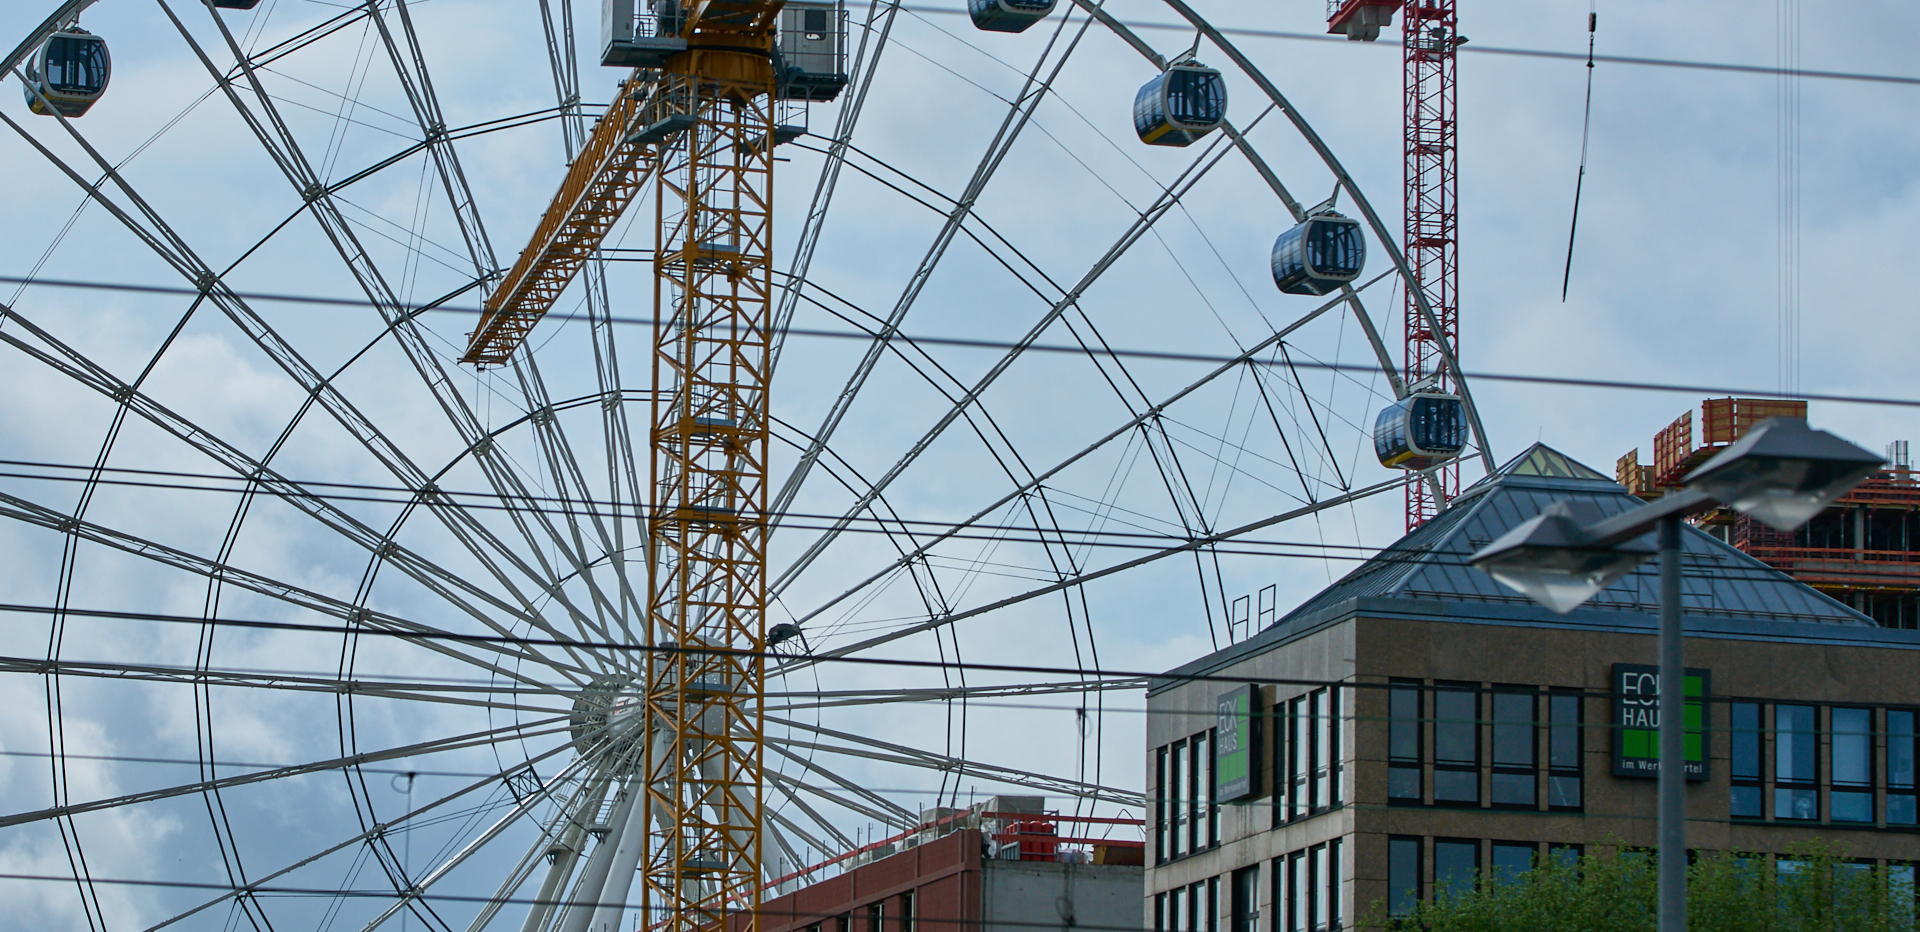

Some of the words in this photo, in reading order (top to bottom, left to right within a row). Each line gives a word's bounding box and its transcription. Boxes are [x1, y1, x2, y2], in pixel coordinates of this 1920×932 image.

[1219, 698, 1238, 735] ECK
[1622, 708, 1661, 727] HAU
[1219, 732, 1238, 755] HAUS
[1621, 759, 1635, 769] im
[1638, 760, 1703, 773] Werrtel
